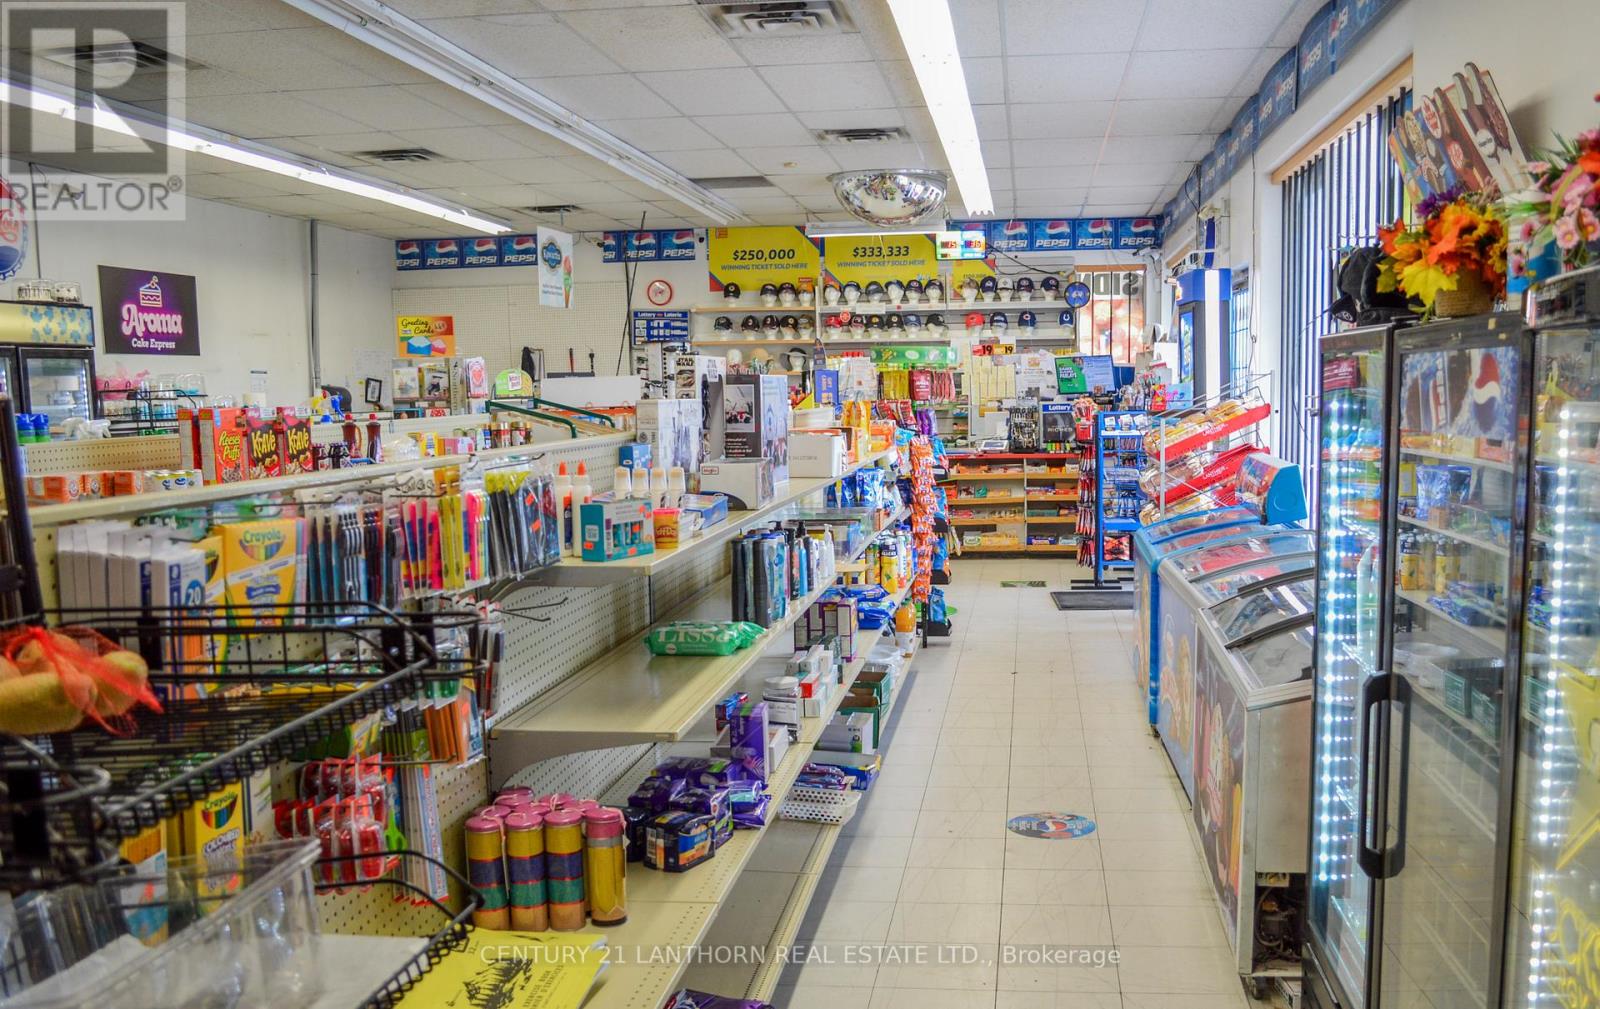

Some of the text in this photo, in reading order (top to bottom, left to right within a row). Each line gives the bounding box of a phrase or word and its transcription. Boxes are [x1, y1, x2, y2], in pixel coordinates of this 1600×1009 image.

[993, 240, 1027, 248] PEPSI
[1035, 238, 1070, 247] PEPSI
[1077, 237, 1112, 246] PEPSI
[1120, 237, 1155, 246] PEPSI
[732, 248, 796, 262] $250,000
[852, 245, 910, 259] $333,333
[427, 257, 458, 266] PEPSI
[465, 256, 497, 265] PEPSI
[504, 254, 536, 263] PEPSI
[720, 263, 751, 271] WINNING
[837, 261, 867, 269] WINNING
[867, 260, 890, 268] TICKET
[121, 303, 183, 337] Aroma
[401, 318, 429, 329] Greeting
[414, 325, 434, 334] Cards
[131, 338, 176, 351] Cake Express
[982, 345, 993, 355] 19
[1004, 346, 1013, 354] 19
[223, 445, 241, 461] Puffs
[243, 530, 281, 544] Crayola
